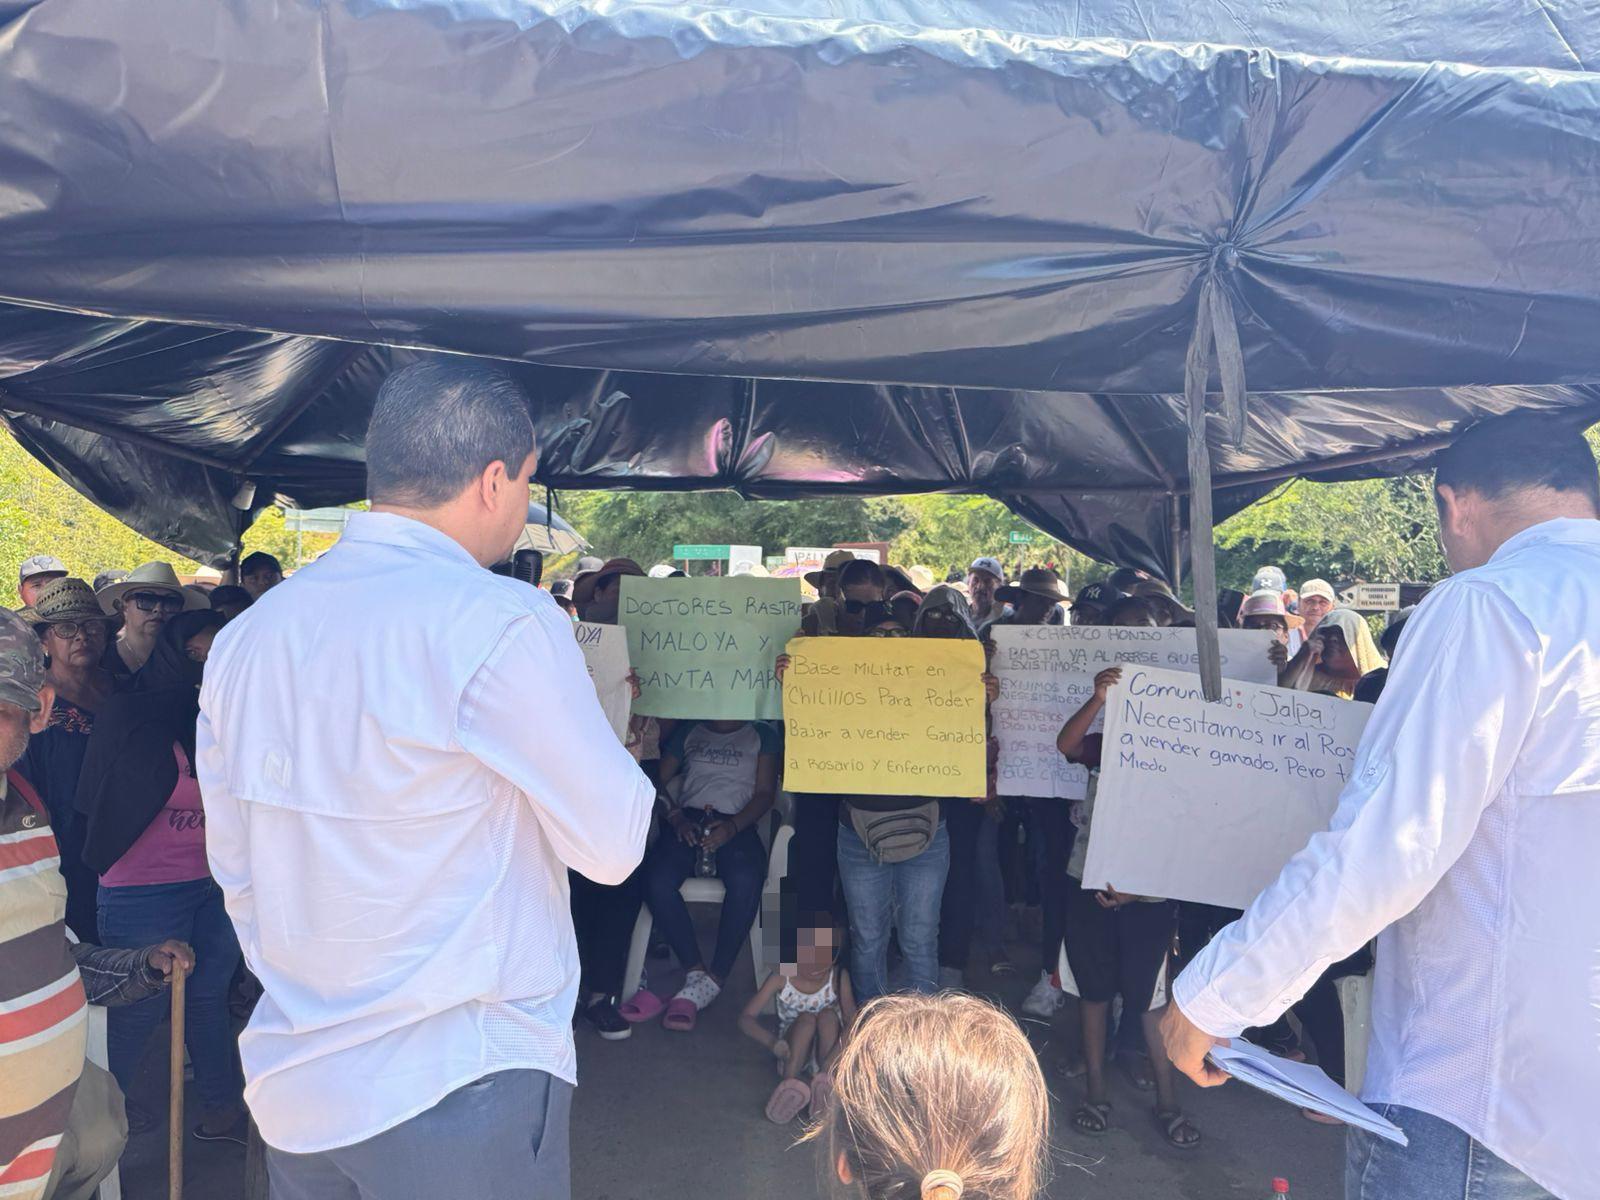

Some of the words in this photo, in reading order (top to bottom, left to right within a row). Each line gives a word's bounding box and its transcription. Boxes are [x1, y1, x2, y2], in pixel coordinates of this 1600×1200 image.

[625, 596, 733, 616] DOCTORES
[575, 623, 603, 644] OYA
[640, 631, 738, 652] MALOYA
[1108, 628, 1162, 641] HONDO
[793, 654, 841, 676] Base
[926, 664, 946, 677] en
[1008, 647, 1060, 661] BASTA
[1069, 647, 1088, 662] YA
[1167, 652, 1200, 665] QUE
[730, 668, 777, 691] MAR
[1067, 683, 1093, 696] QUE
[878, 687, 913, 707] Para
[925, 688, 977, 708] Poder
[1256, 690, 1323, 725] Jalpa
[789, 718, 832, 740] Bajar
[840, 730, 852, 740] a
[856, 727, 910, 741] vender
[926, 724, 985, 745] Ganado
[1124, 698, 1264, 746] Necesitamos
[1273, 731, 1286, 747] ir
[1294, 730, 1310, 752] al
[1318, 732, 1355, 761] Ros
[1119, 732, 1134, 746] a
[1139, 733, 1201, 758] vender
[1284, 755, 1326, 779] Pero
[1119, 751, 1167, 774] Miedo
[789, 757, 799, 770] a
[808, 757, 865, 772] Rosario
[887, 759, 962, 777] Enfermos
